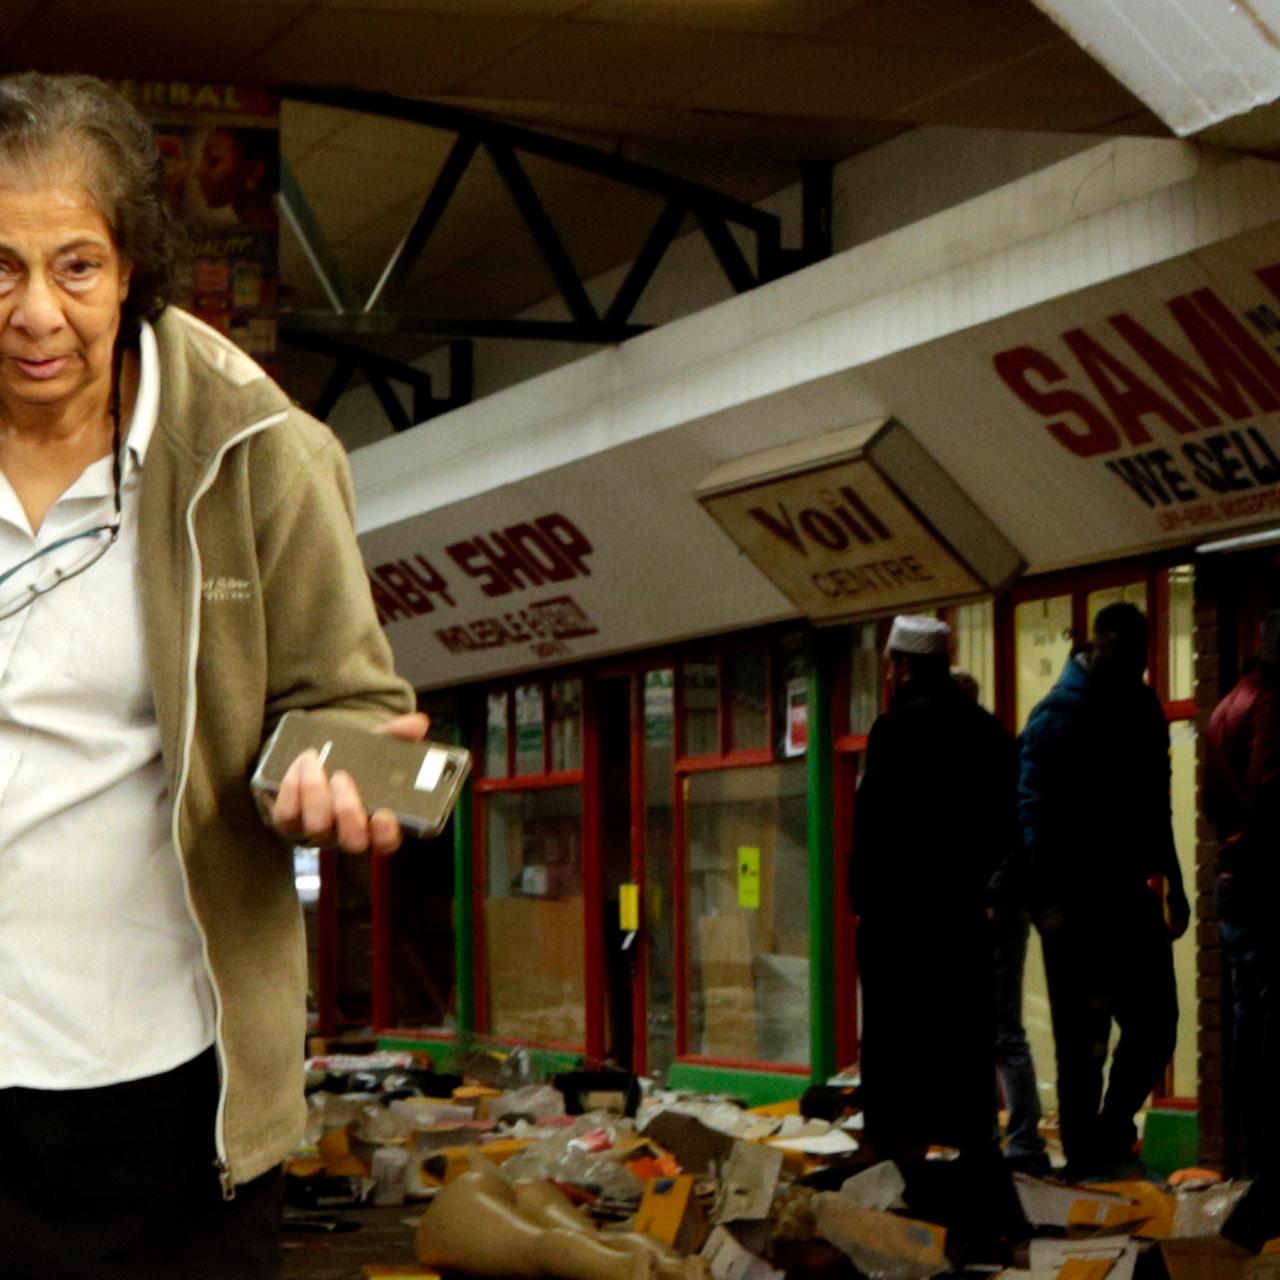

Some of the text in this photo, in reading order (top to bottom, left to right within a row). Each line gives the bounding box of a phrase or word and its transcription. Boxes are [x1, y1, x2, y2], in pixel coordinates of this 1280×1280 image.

[1105, 448, 1198, 508] WE
[445, 512, 594, 597] SHOP
[811, 554, 936, 599] CENTRE
